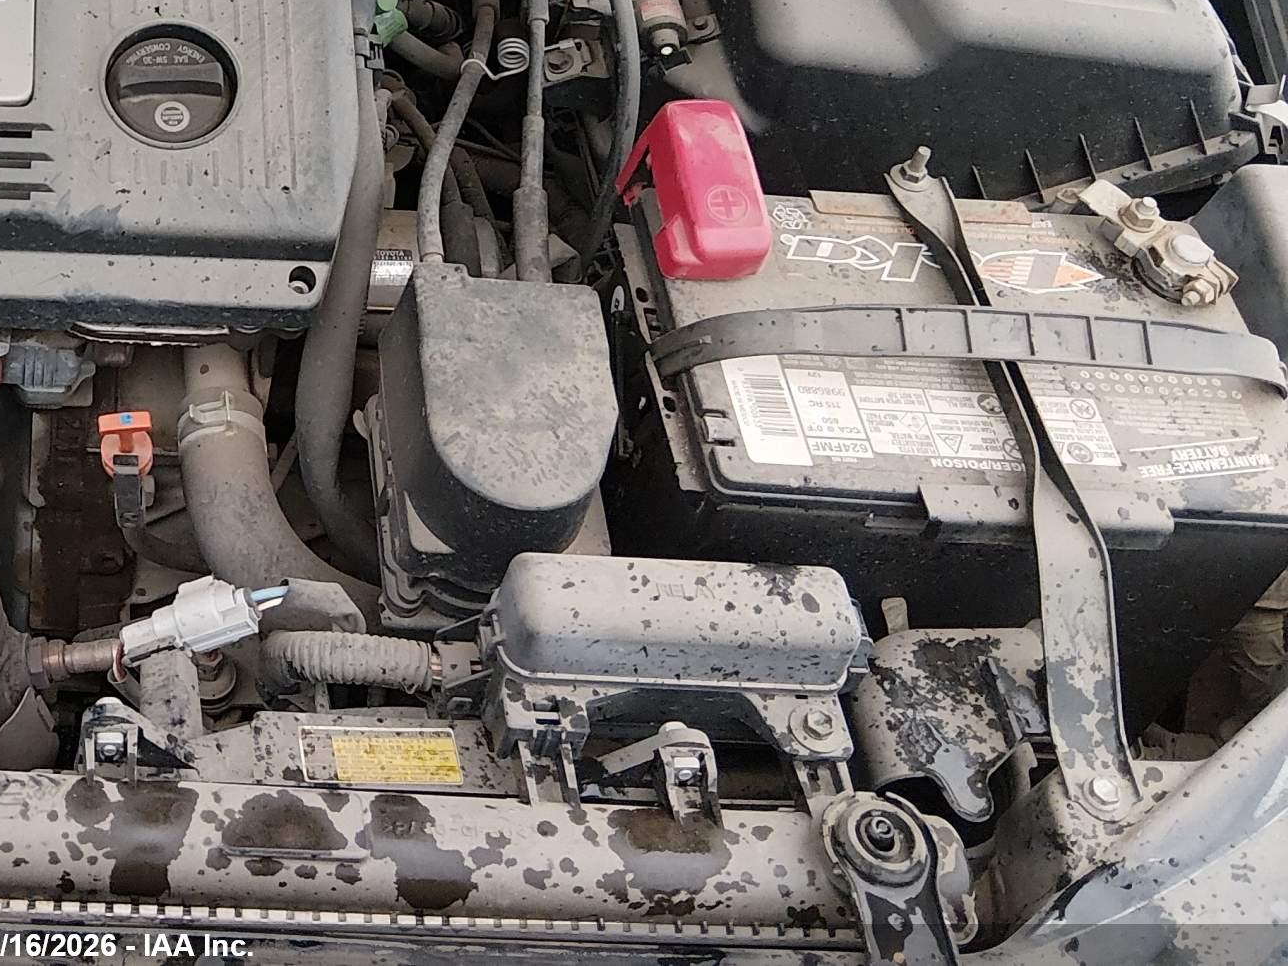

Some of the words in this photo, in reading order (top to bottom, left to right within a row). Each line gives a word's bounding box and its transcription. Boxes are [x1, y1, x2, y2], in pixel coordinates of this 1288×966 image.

[177, 44, 206, 63] ENERGY
[806, 399, 825, 409] RC
[836, 424, 862, 435] CCA
[811, 440, 869, 456] 624FMF
[1170, 444, 1233, 461] BATTERY
[1140, 451, 1273, 479] MAINTENANCE-FREE
